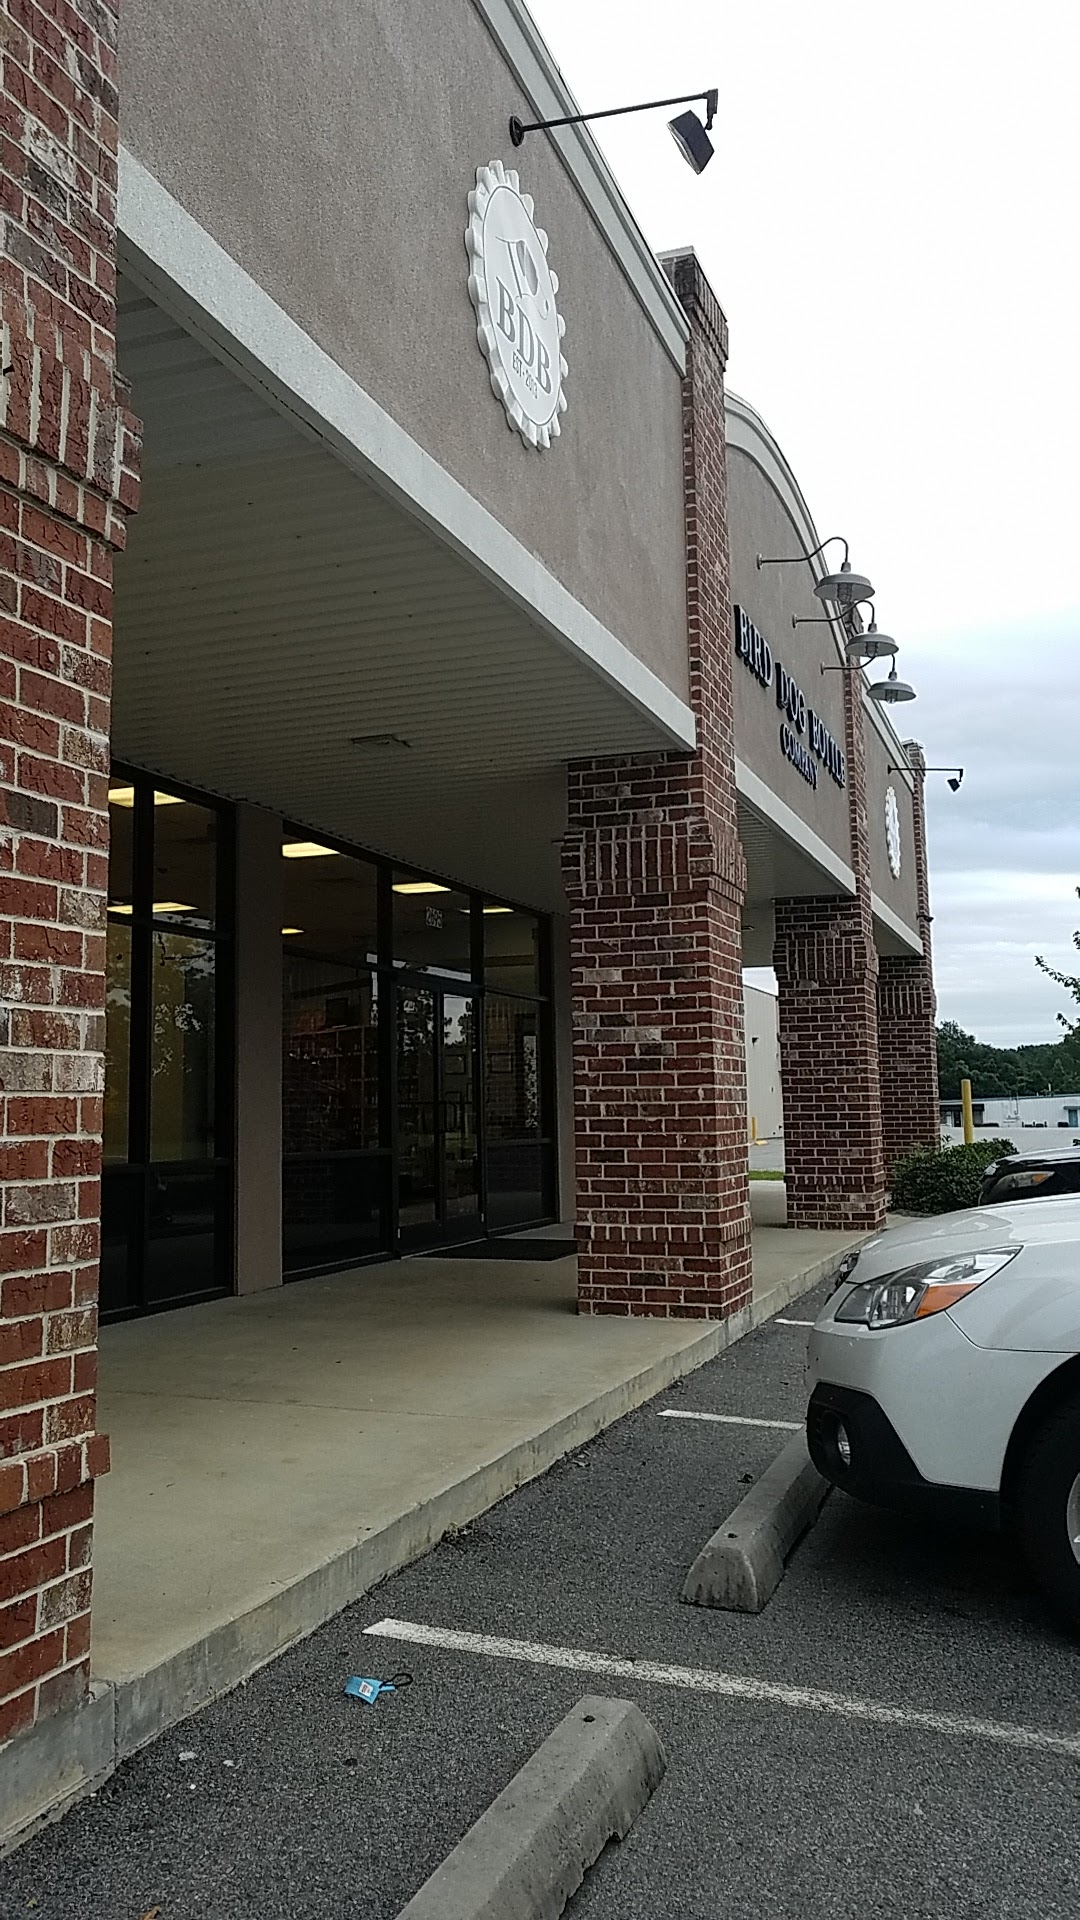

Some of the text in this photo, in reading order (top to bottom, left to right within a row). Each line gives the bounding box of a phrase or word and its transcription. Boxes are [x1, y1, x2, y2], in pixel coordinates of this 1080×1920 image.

[495, 276, 551, 394] BDB
[734, 604, 846, 788] BIRD DOG BOTTLE
[780, 723, 818, 790] COMPANY
